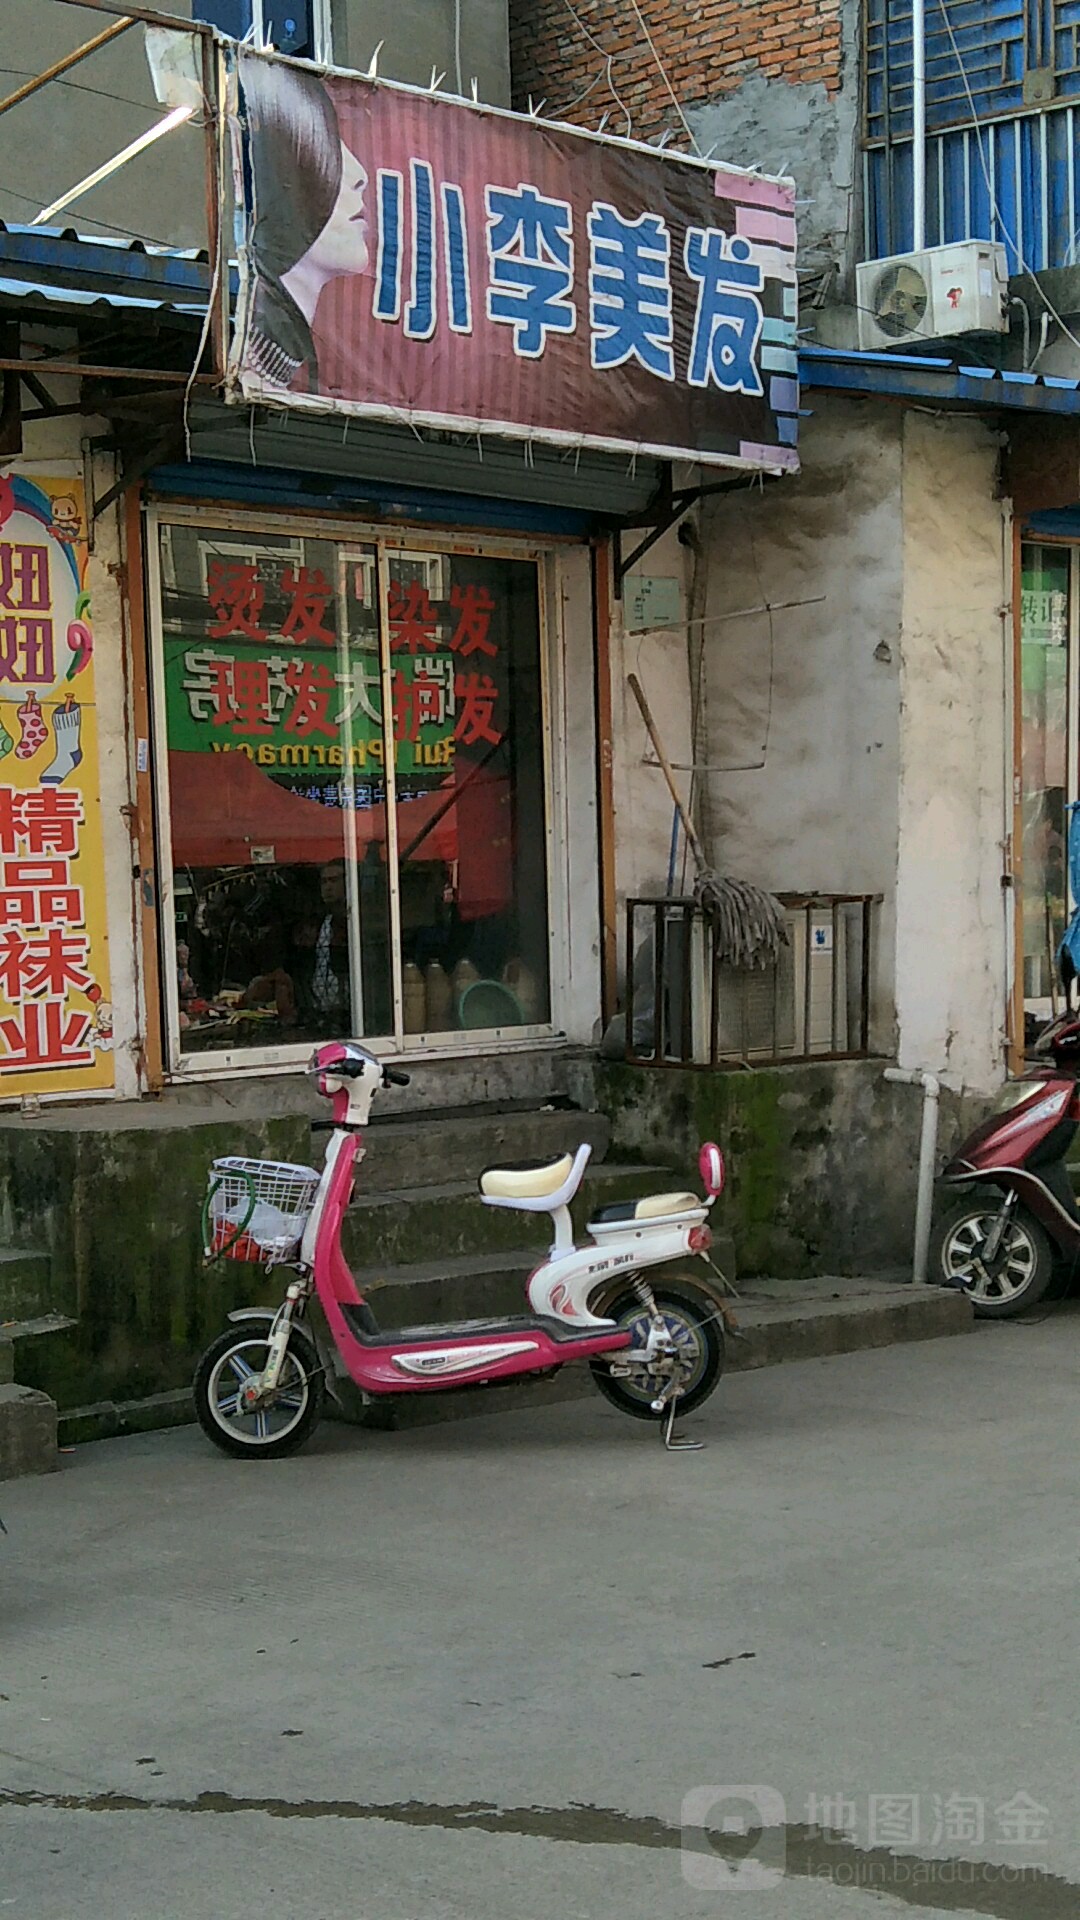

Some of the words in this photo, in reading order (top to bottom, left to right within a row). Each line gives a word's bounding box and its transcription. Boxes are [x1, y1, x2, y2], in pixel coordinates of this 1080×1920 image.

[372, 157, 764, 397] 小李美发
[207, 561, 338, 645] 烫发
[387, 580, 498, 656] 染发
[209, 661, 341, 739] 理发
[390, 671, 503, 746] 护发
[0, 787, 93, 1068] 精品袜业
